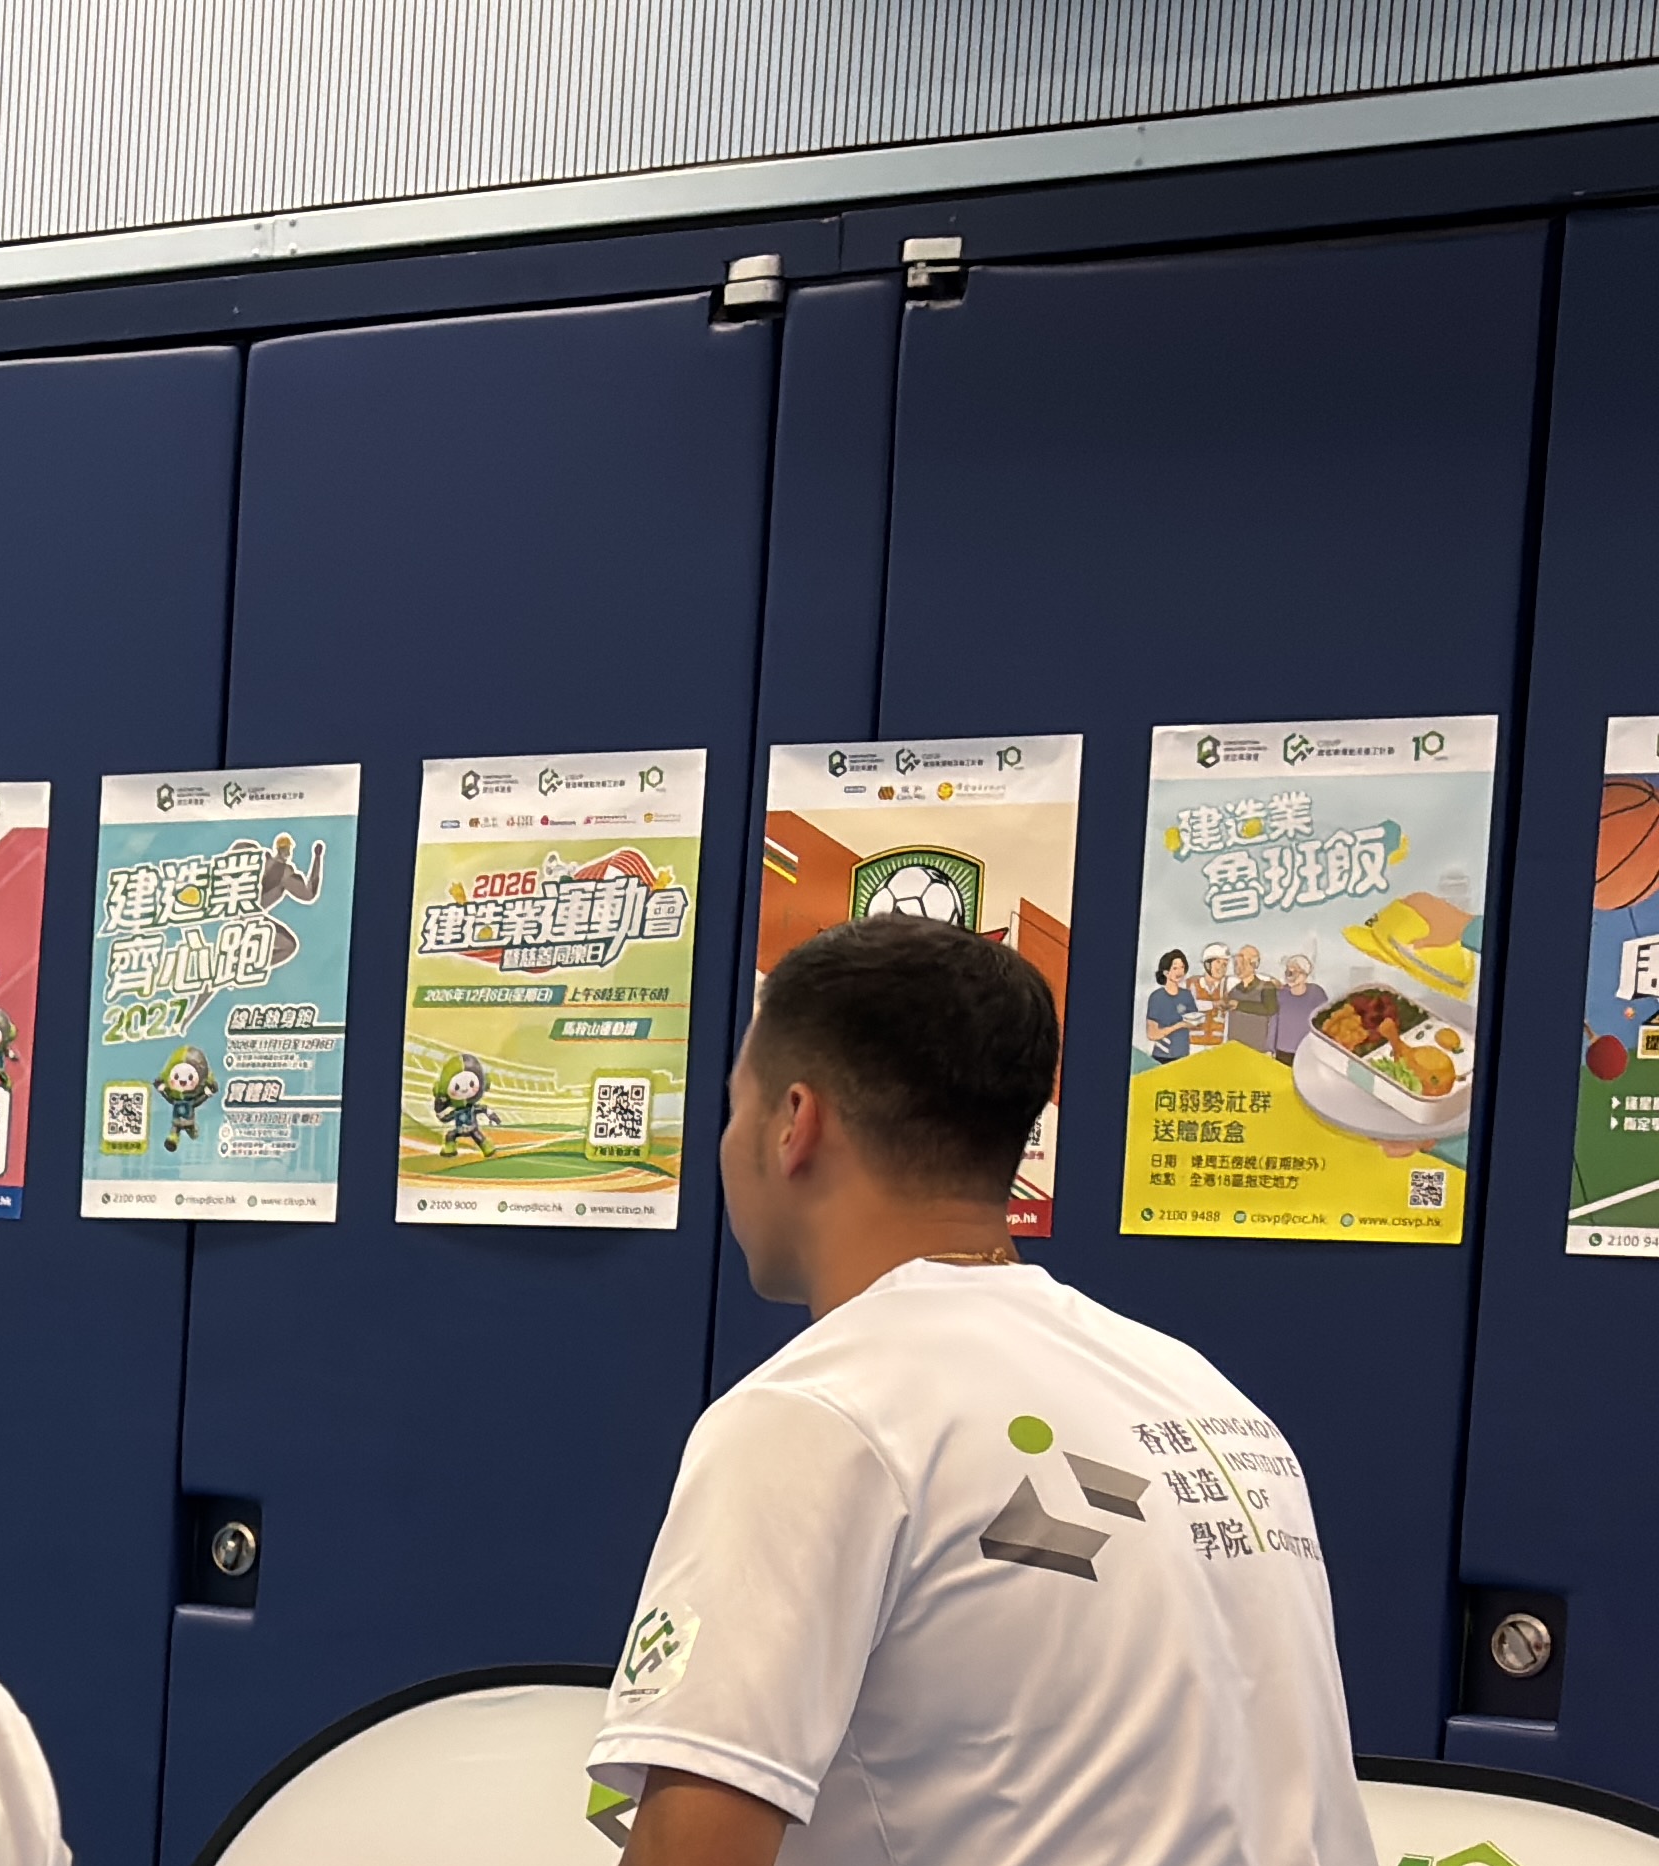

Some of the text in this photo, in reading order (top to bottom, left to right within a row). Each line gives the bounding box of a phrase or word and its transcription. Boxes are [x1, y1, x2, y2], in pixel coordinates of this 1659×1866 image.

[1178, 791, 1314, 856] 建造業
[473, 871, 537, 898] 2026
[1202, 827, 1389, 921] 魯班飯
[107, 851, 264, 930] 建造業
[421, 877, 687, 957] 建造業運動會
[105, 920, 275, 1000] 齊心跑
[568, 987, 670, 1002] 上午8時至下午6時
[104, 997, 188, 1043] 2027
[1154, 1090, 1272, 1114] 向弱勢社群
[1152, 1120, 1245, 1144] 送贈飯盒
[1151, 1154, 1177, 1169] 日期
[429, 1200, 452, 1210] 2100
[454, 1200, 477, 1210] 9000
[1159, 1209, 1187, 1221] 2100
[1191, 1209, 1220, 1222] 9488
[1006, 1212, 1038, 1225] vp.hk
[1607, 1234, 1639, 1247] 2100
[1132, 1419, 1198, 1455] 香港
[1195, 1417, 1281, 1439] HONG KON
[1162, 1467, 1229, 1505] 建造
[1247, 1488, 1270, 1510] OF
[1189, 1518, 1253, 1561] 學院
